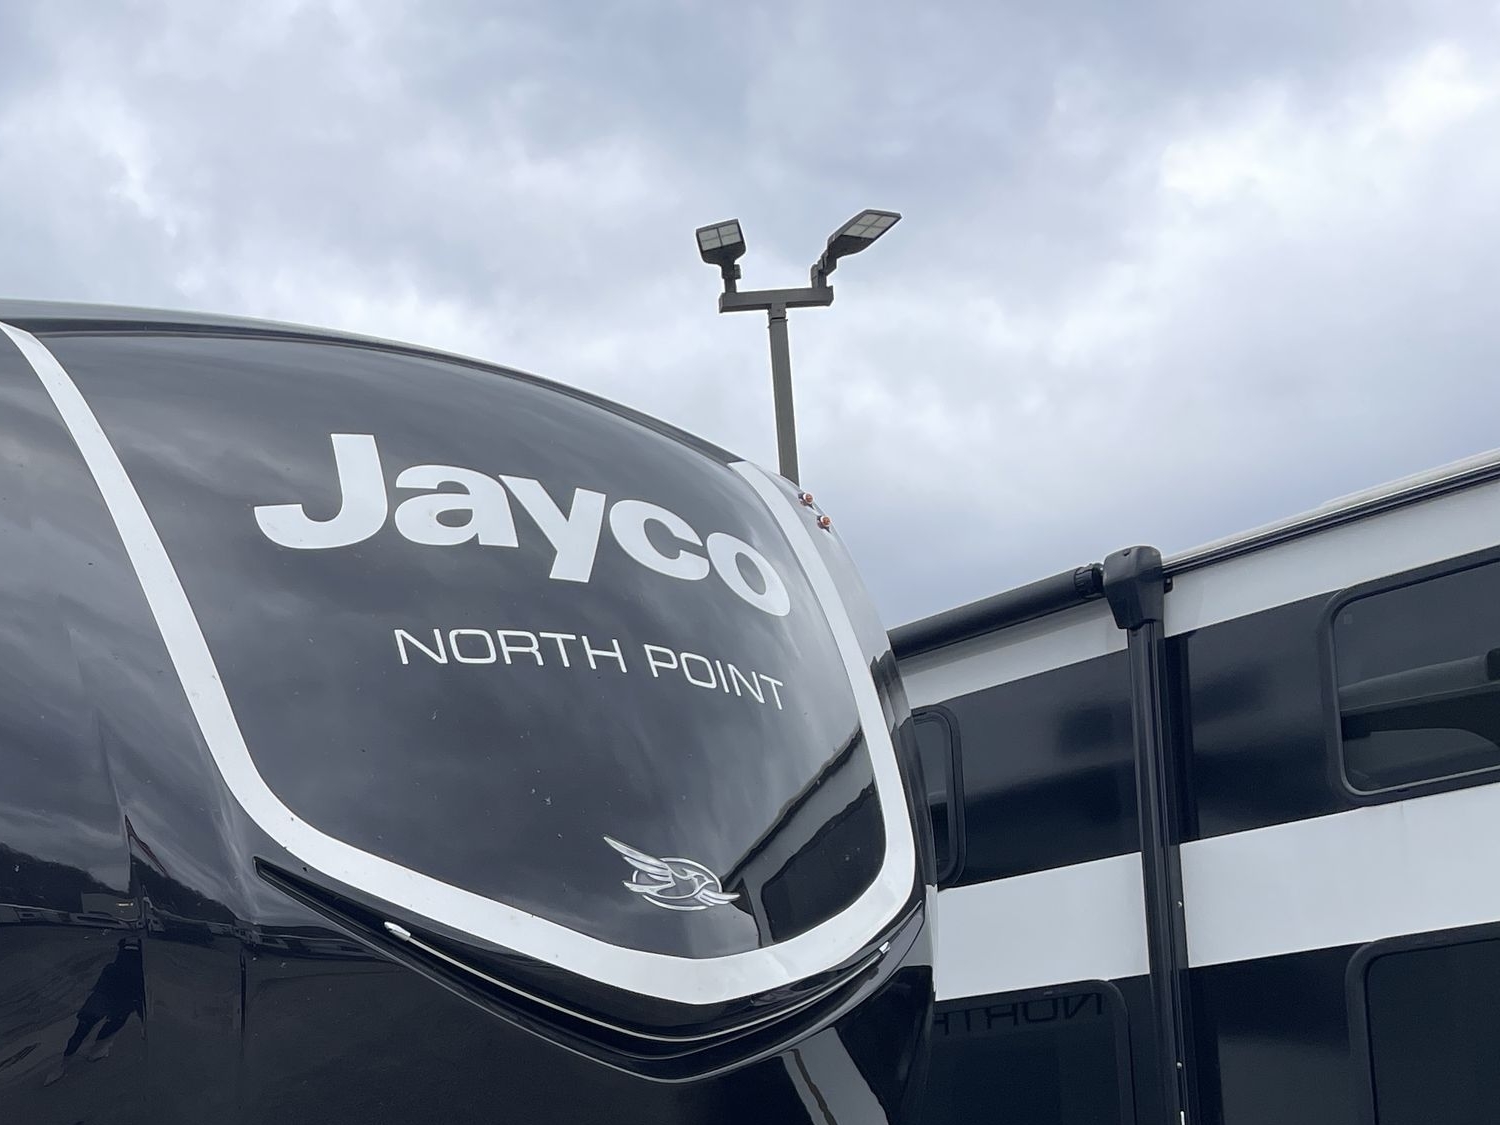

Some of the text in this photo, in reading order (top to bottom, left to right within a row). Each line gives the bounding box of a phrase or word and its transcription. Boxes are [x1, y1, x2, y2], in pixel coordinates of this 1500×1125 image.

[253, 433, 791, 617] Jayco
[393, 628, 785, 711] NORTH POINT
